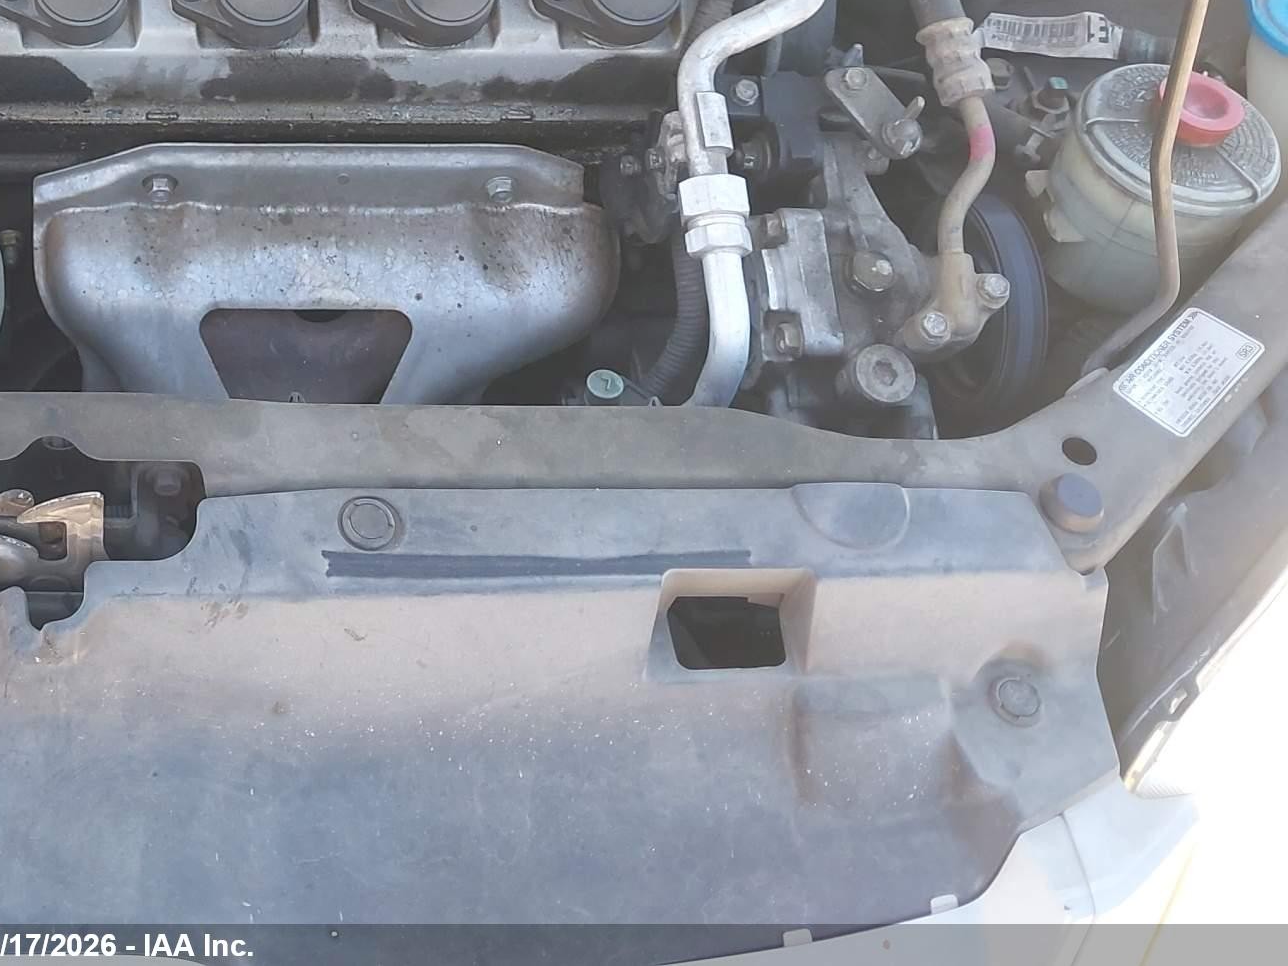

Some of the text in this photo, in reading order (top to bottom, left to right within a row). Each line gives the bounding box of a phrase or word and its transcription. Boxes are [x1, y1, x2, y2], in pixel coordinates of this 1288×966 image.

[1125, 372, 1137, 384] AIR
[1133, 338, 1171, 376] CONDITIONER
[1167, 318, 1191, 341] SYSTEM
